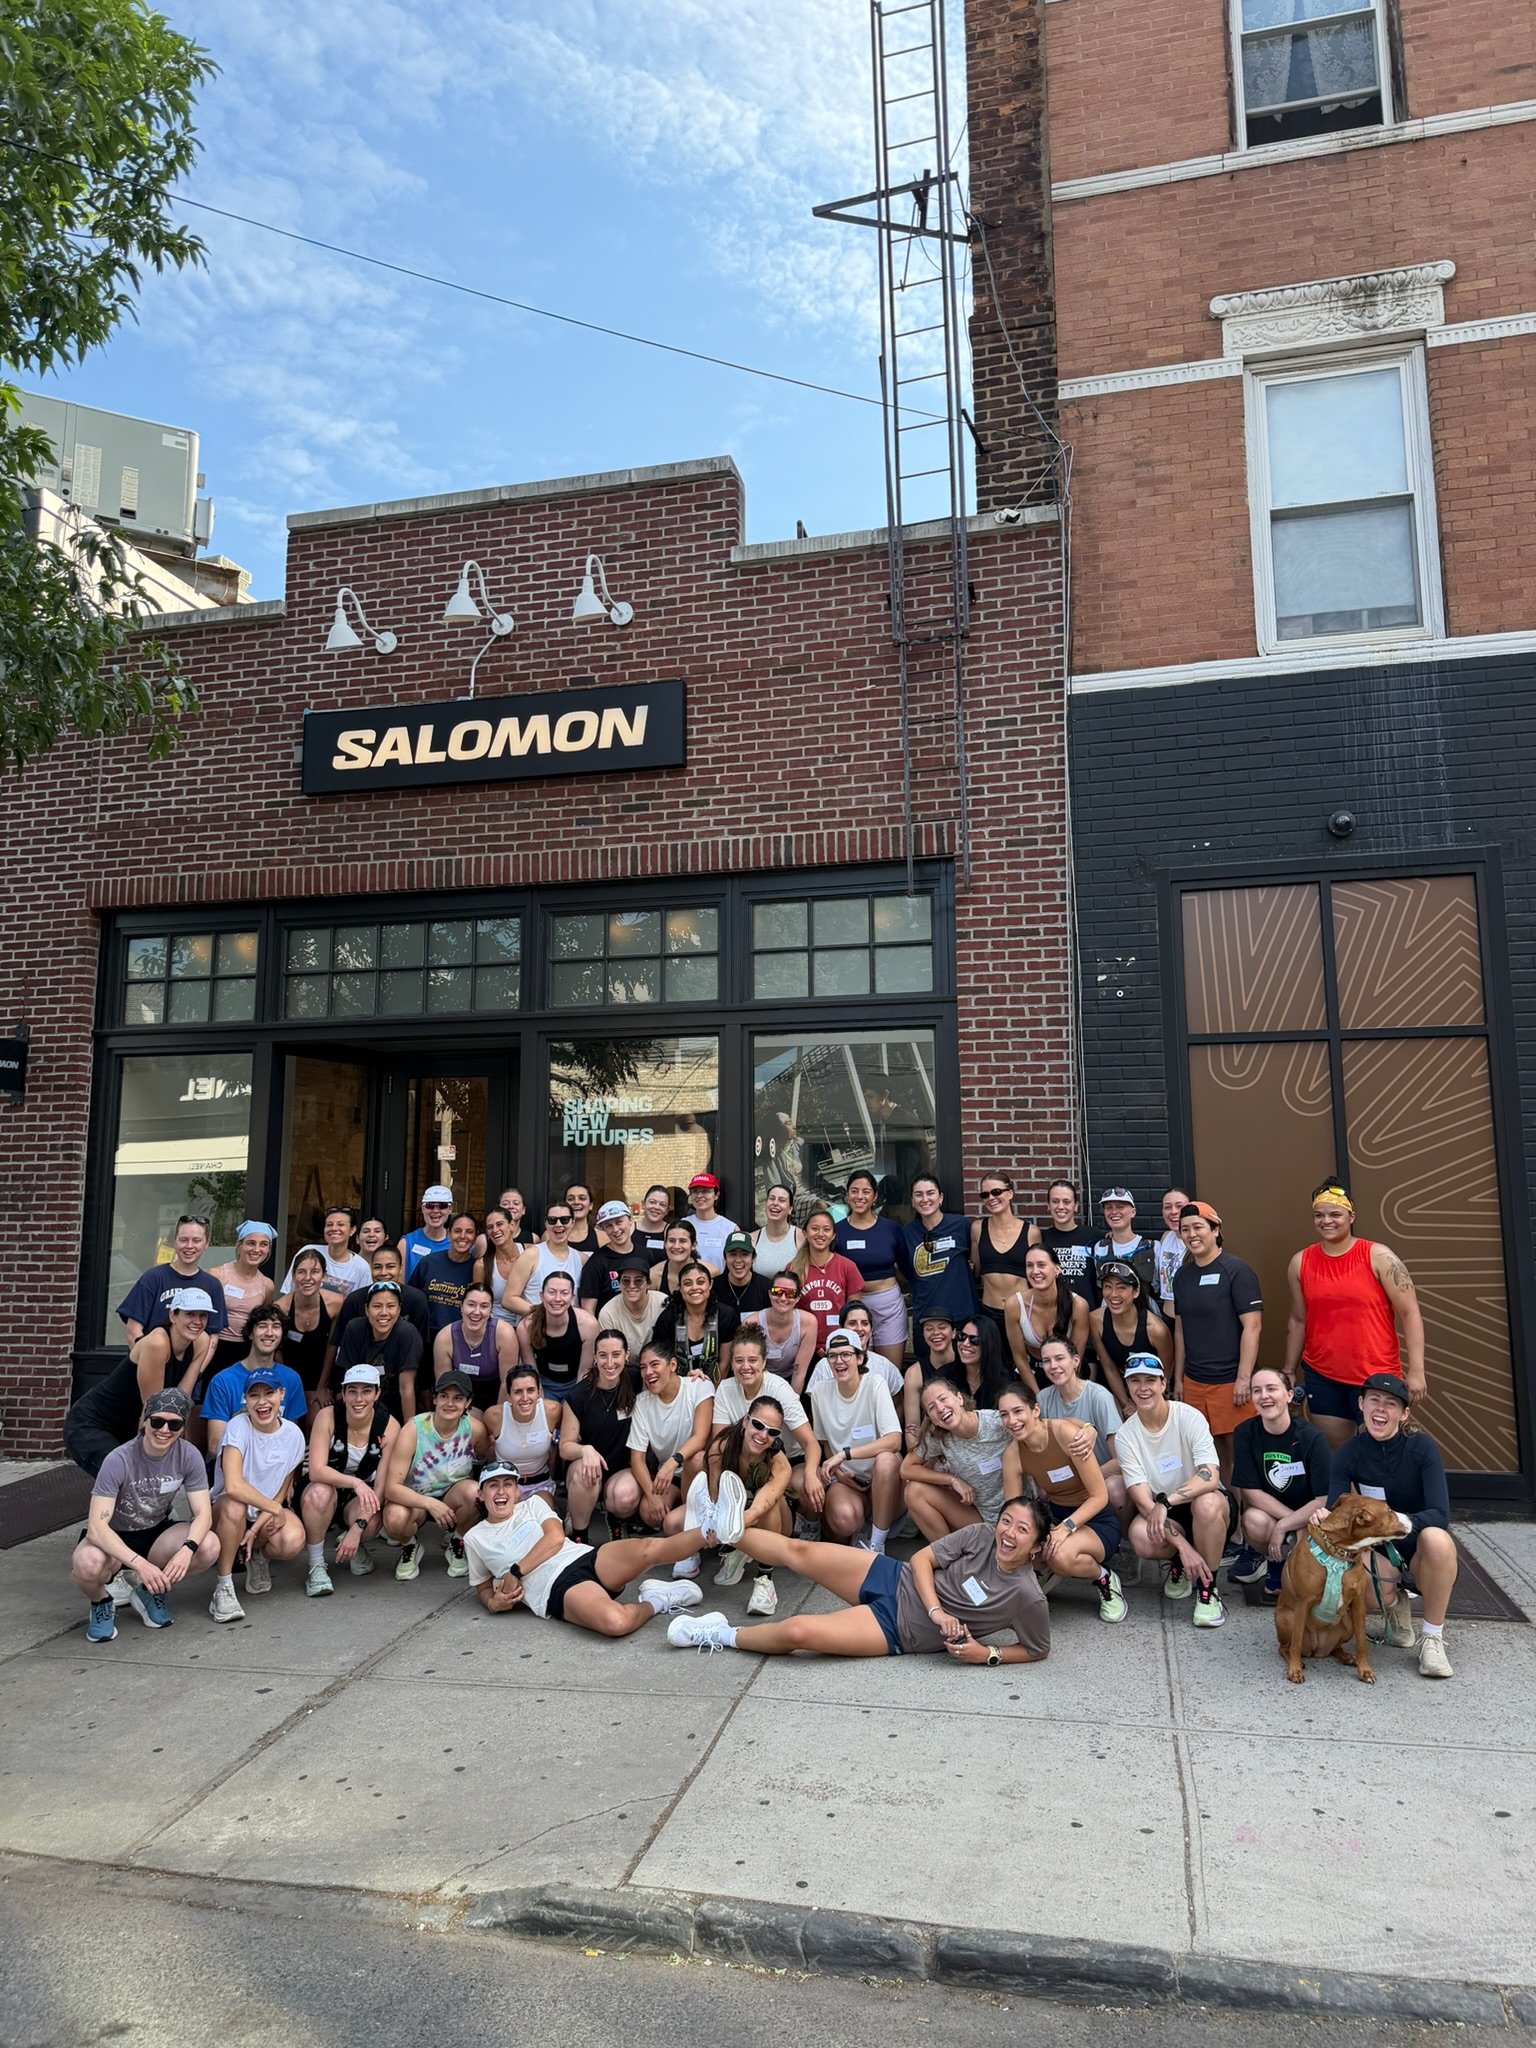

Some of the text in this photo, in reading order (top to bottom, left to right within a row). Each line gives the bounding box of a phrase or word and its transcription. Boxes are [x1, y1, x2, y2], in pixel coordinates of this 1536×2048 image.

[332, 704, 649, 771] SALOMON
[563, 1095, 653, 1116] SHAPING
[563, 1114, 609, 1131] NEW
[563, 1128, 655, 1147] FUTURES
[428, 1278, 466, 1299] Sammy's
[801, 1280, 841, 1296] NEWPORT BEACH
[817, 1289, 825, 1297] CA
[814, 1301, 829, 1309] 1995
[1265, 1453, 1290, 1461] BOSTON
